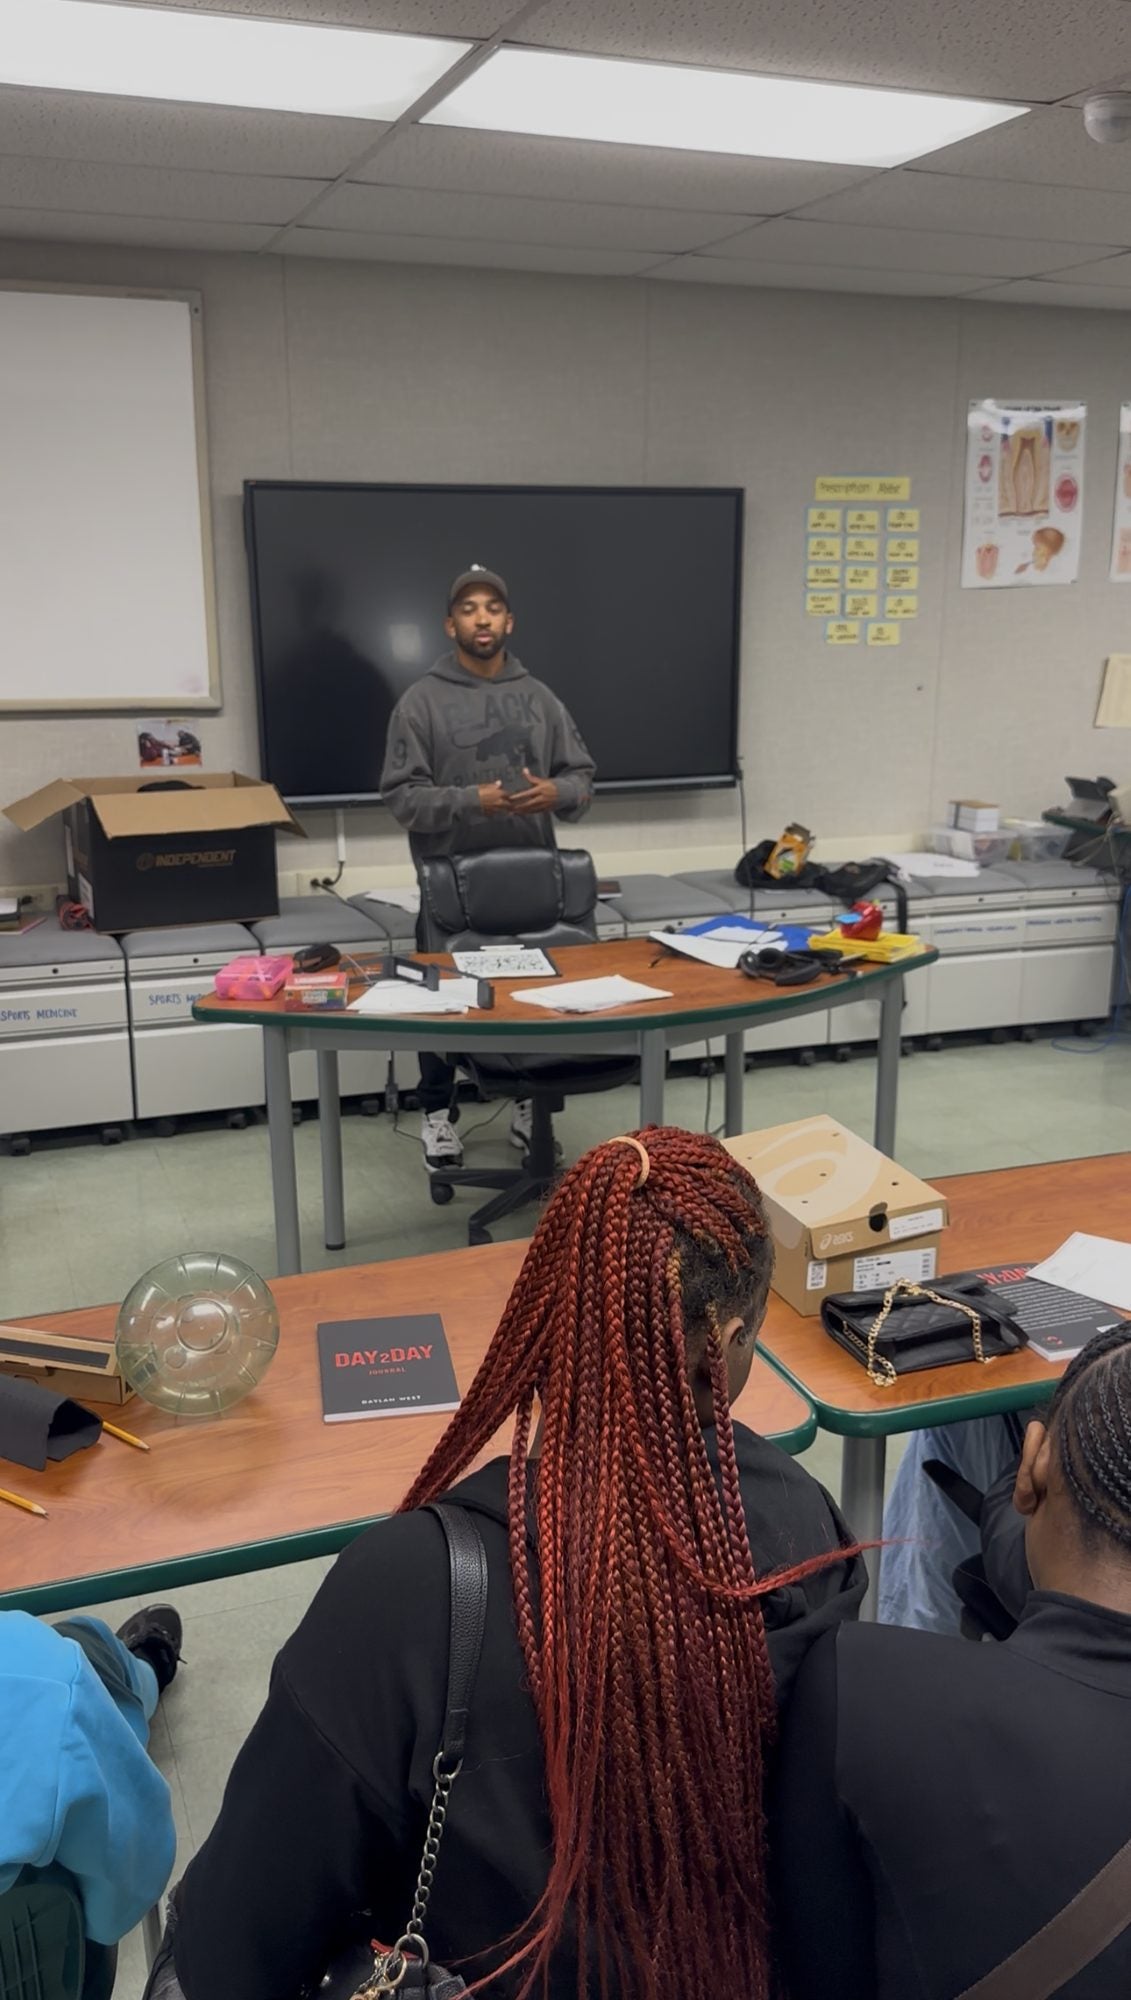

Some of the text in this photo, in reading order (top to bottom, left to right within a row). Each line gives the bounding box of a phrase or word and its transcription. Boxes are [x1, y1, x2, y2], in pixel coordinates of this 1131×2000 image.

[155, 850, 237, 867] INDEPENDENT
[149, 992, 182, 1006] SPORTS
[1, 1008, 77, 1022] SPORTS MEDICINE
[335, 1344, 432, 1367] DAY2DAY
[369, 1367, 406, 1375] JOURNAL
